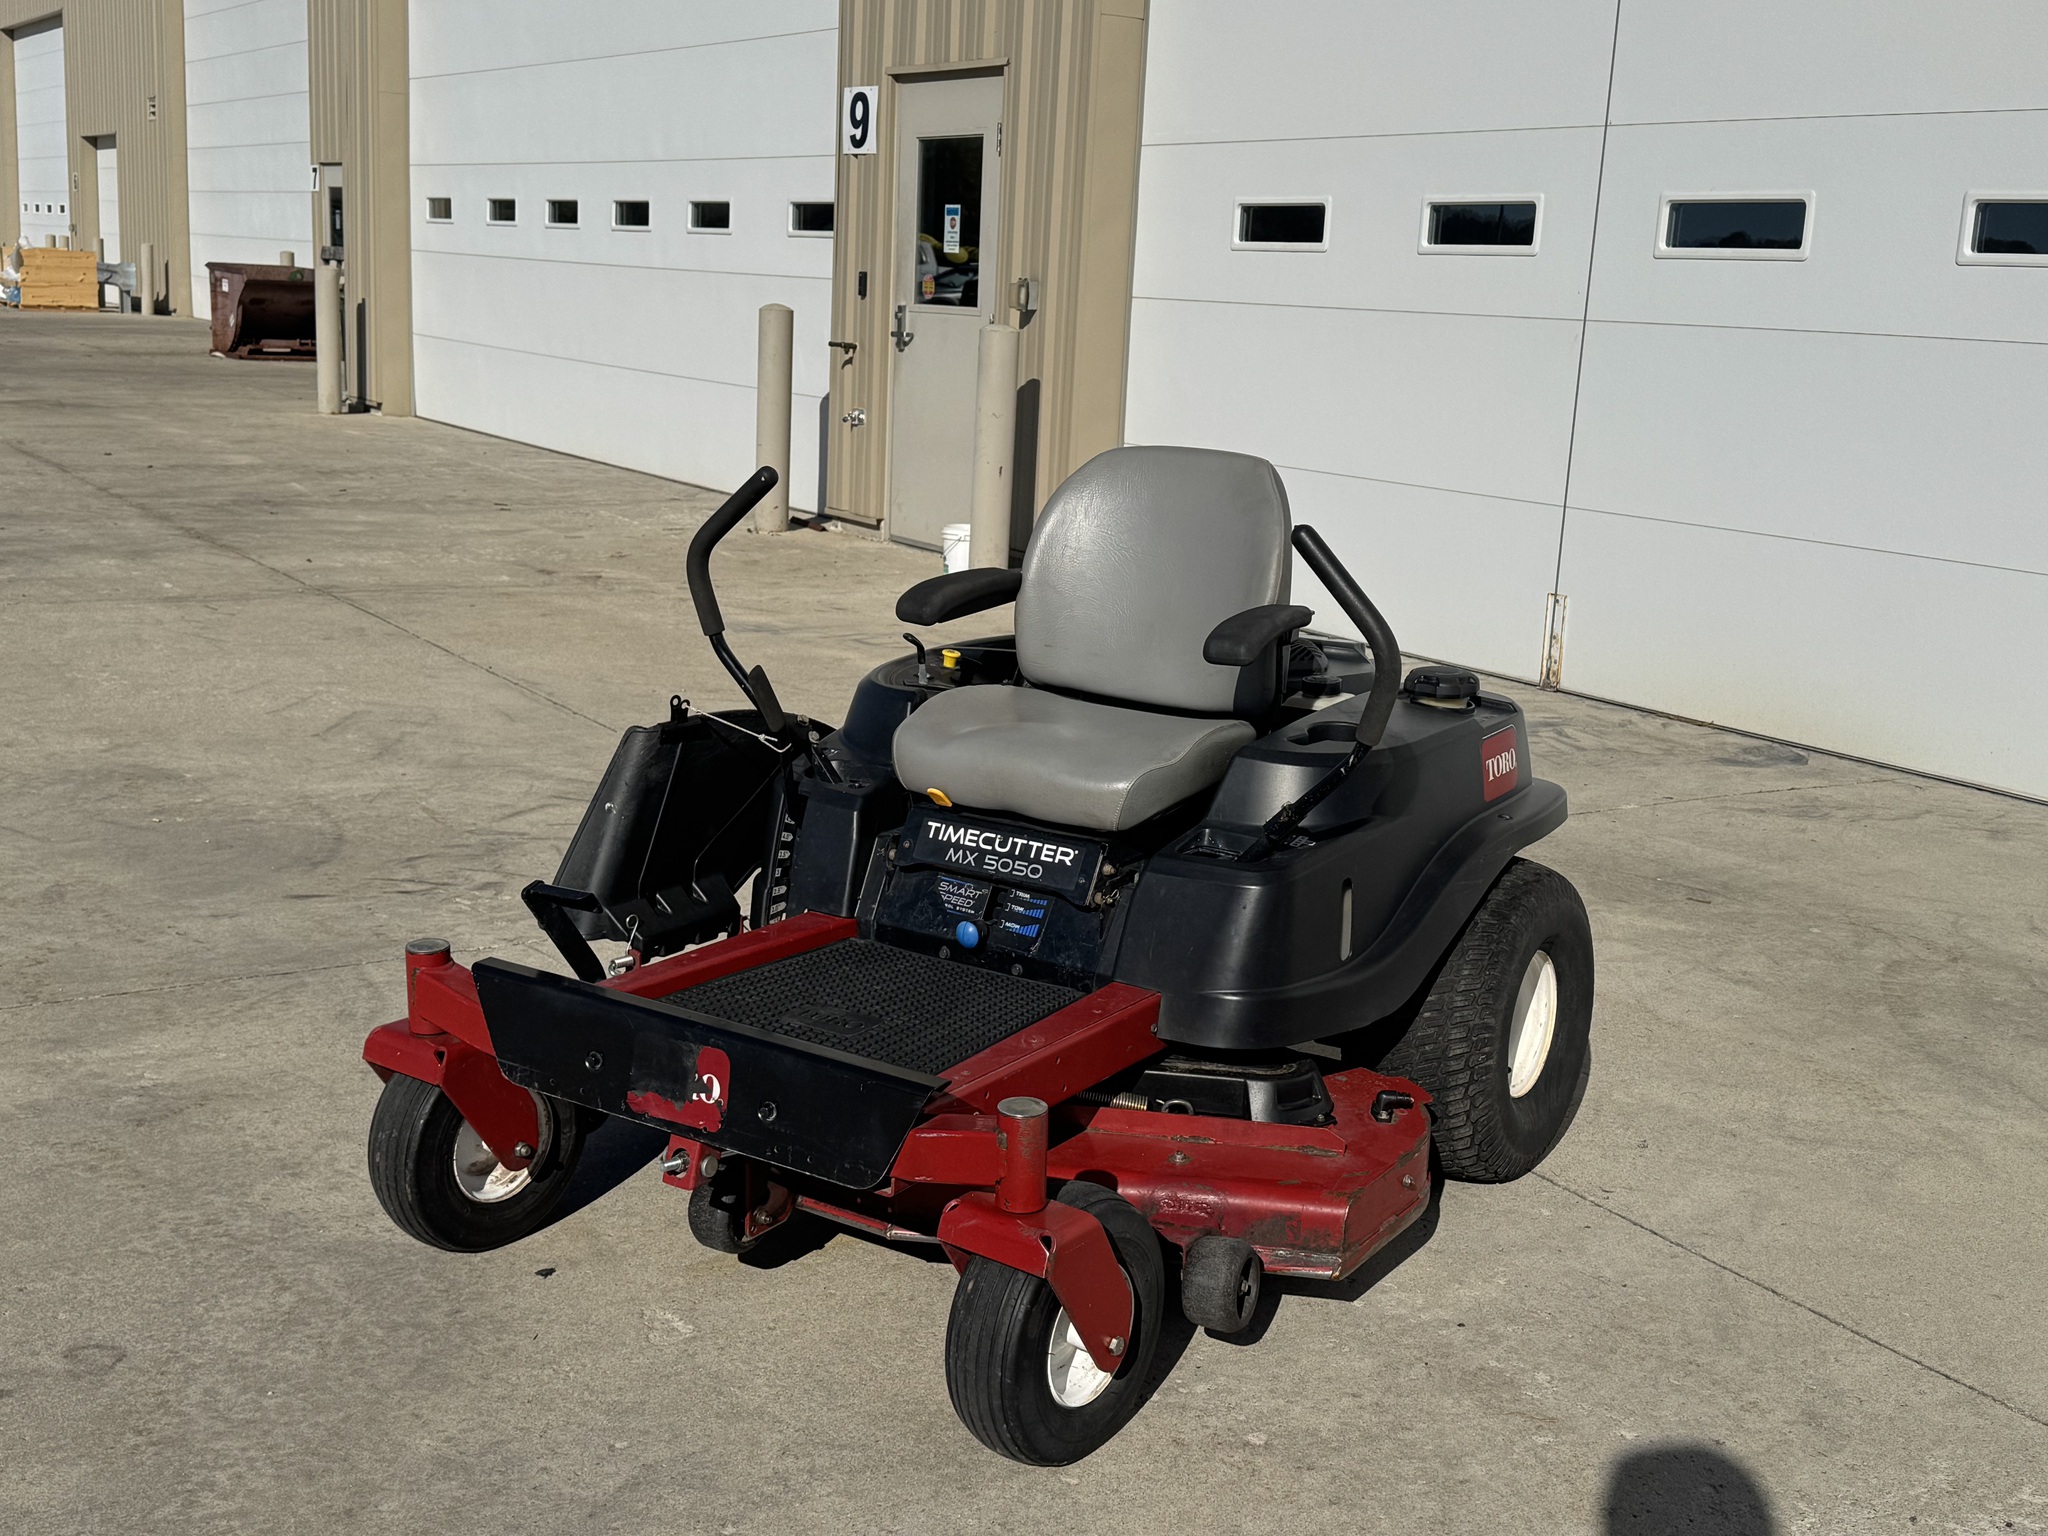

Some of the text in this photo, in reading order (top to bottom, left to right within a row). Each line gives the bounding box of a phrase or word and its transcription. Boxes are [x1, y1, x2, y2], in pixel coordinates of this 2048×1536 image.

[849, 91, 870, 149] 9
[311, 167, 318, 190] 7
[1485, 747, 1516, 782] TORO
[927, 821, 1075, 866] TIMECUTTER
[945, 847, 1043, 879] MX 5050
[938, 881, 983, 899] SMART
[1016, 891, 1030, 899] TRIM
[1005, 921, 1020, 929] MOW
